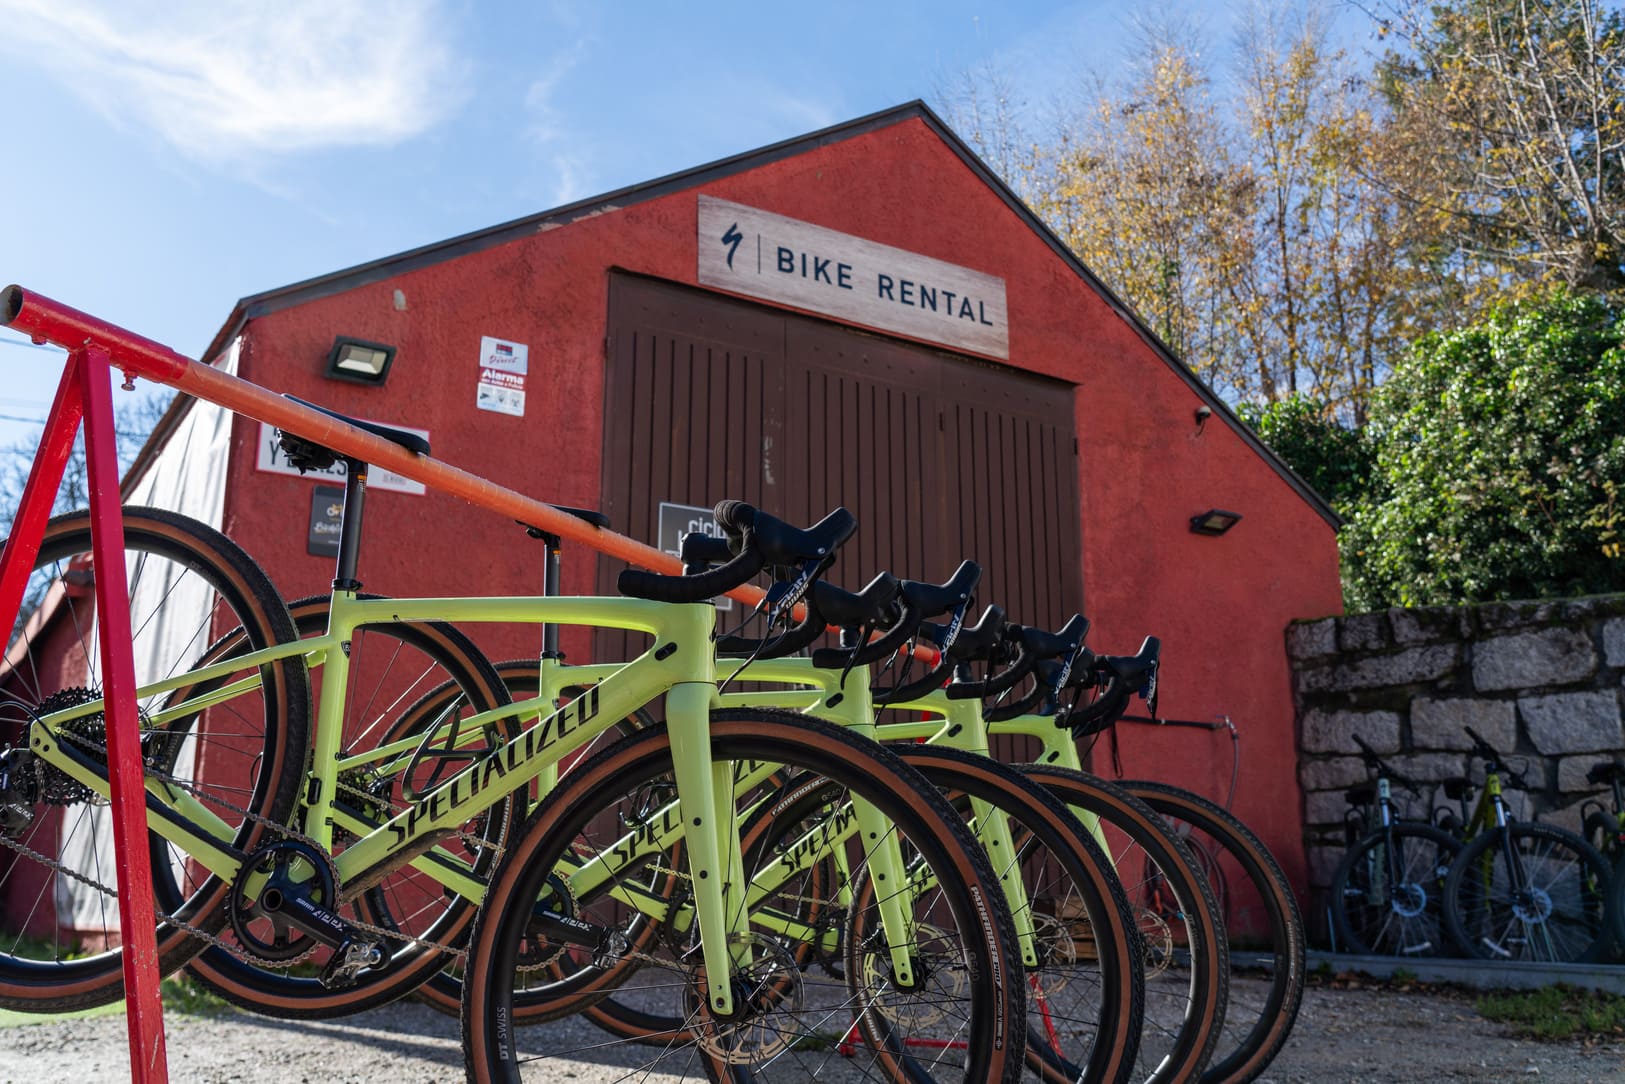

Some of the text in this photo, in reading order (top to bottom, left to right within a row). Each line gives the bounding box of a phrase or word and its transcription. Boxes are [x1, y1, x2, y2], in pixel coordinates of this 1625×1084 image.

[777, 246, 993, 326] BIKE RENTAL
[482, 368, 524, 385] Alarma
[387, 682, 600, 851] SPECIALIZED
[496, 1007, 509, 1060] DT SWISS
